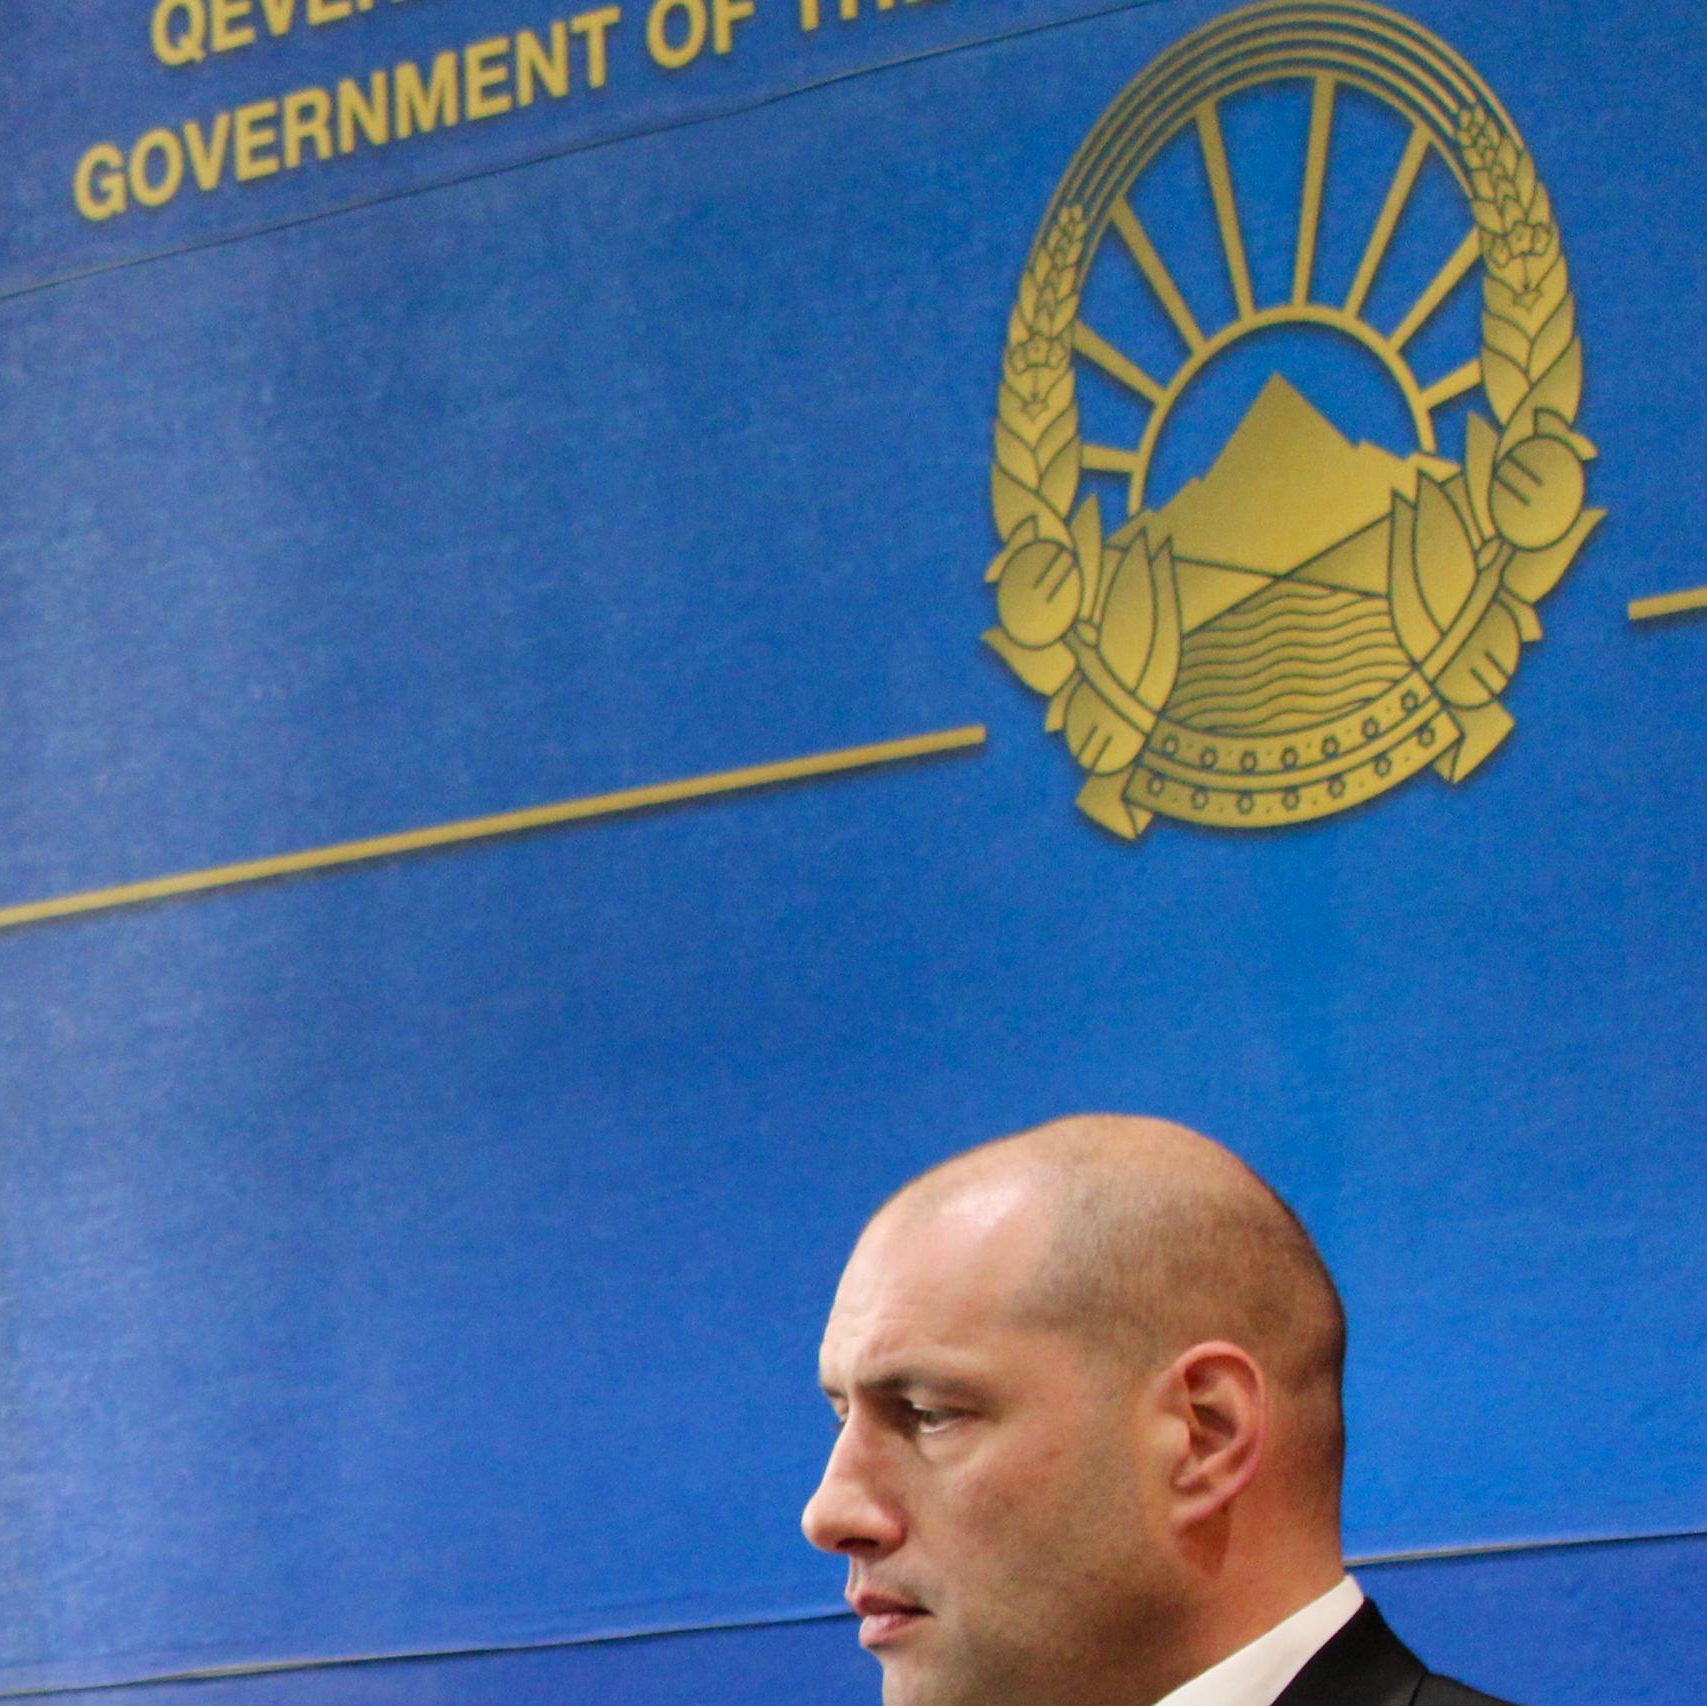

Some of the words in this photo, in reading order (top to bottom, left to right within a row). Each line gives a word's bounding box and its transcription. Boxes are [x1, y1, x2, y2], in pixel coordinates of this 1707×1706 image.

[149, 0, 405, 66] QEV
[73, 5, 622, 222] GOVERNMENT
[647, 0, 756, 68] OF
